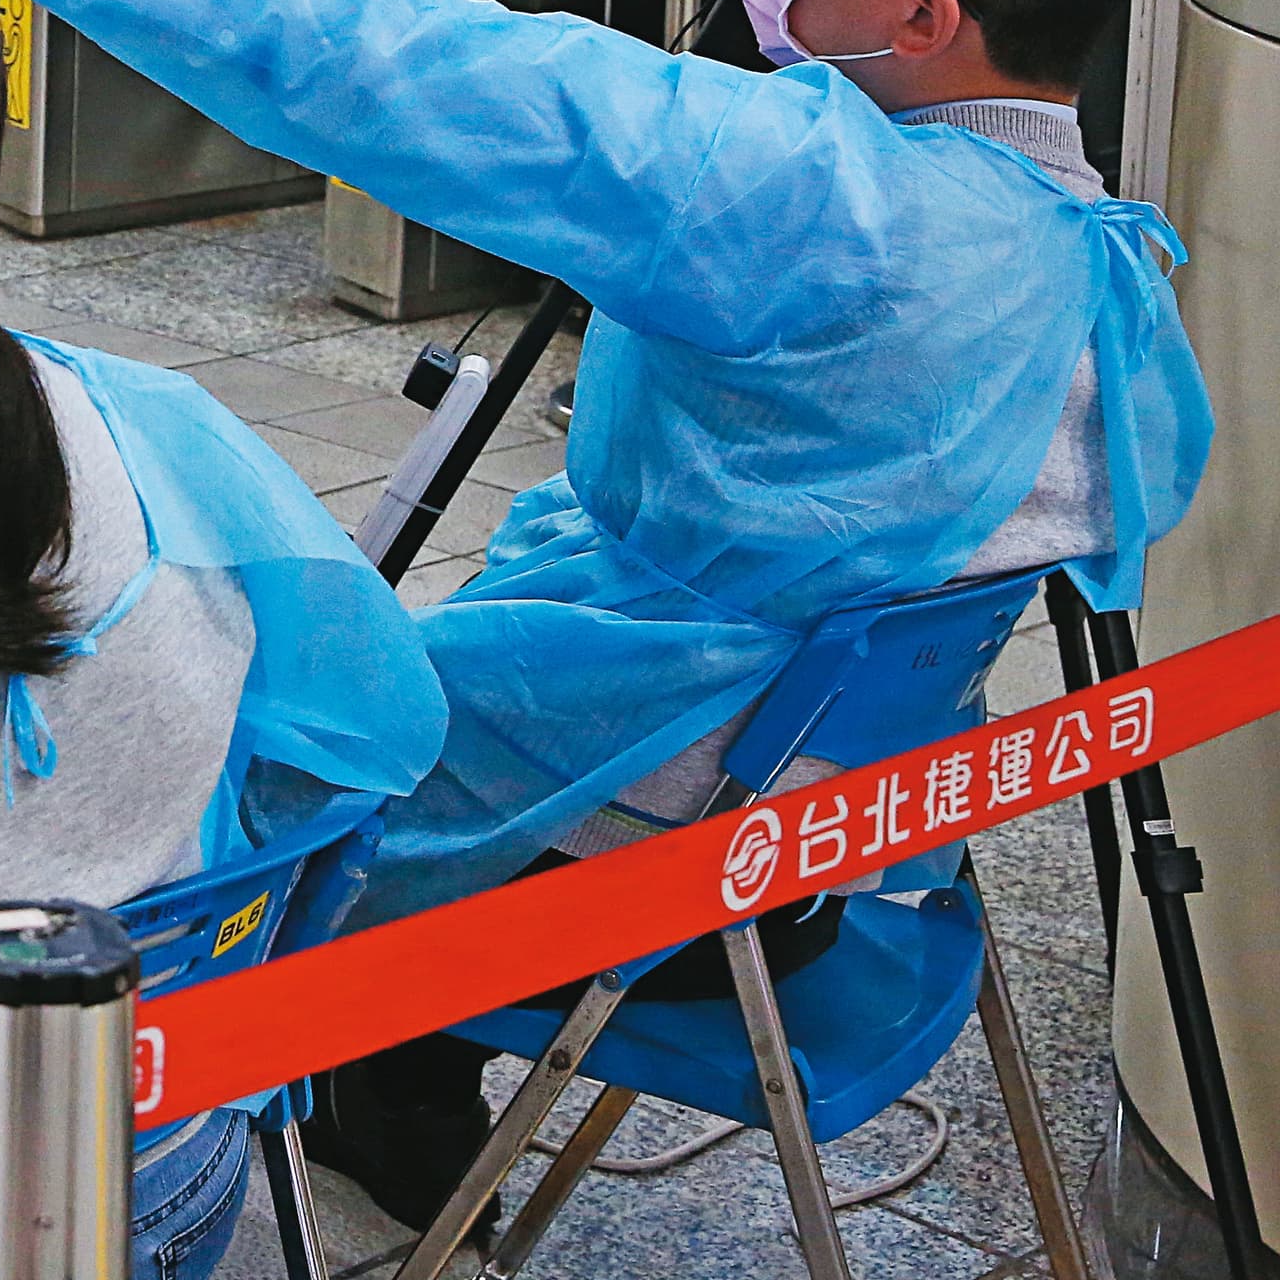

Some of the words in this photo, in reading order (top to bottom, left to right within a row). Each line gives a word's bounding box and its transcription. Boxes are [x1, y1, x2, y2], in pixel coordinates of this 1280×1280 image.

[797, 685, 1155, 880] 台北捷運公司
